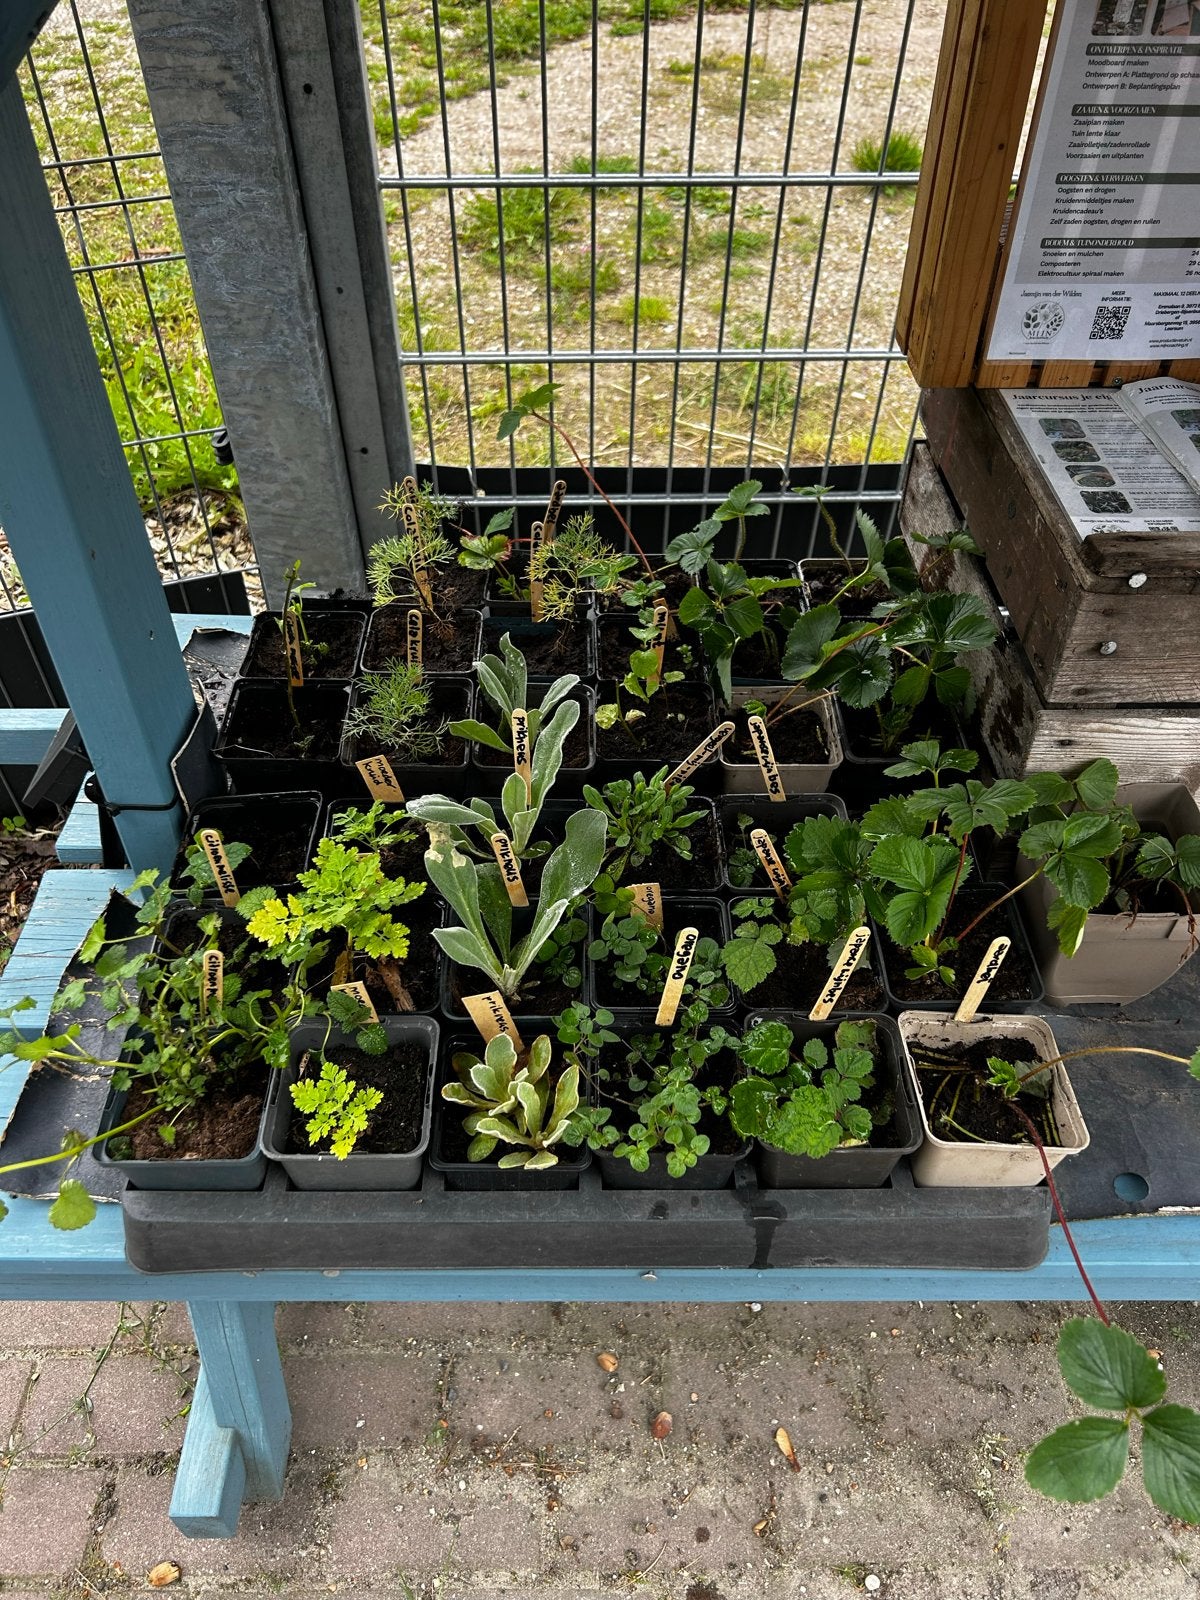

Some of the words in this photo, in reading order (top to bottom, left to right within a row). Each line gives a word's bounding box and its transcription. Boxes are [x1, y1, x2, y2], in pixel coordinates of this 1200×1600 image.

[1128, 83, 1181, 91] Beplantingsplan
[1076, 106, 1102, 114] ZAAIEN
[1110, 106, 1156, 114] VOORZAAIEN
[1073, 119, 1101, 127] Zaaiplan
[1111, 152, 1144, 160] uitplanten
[672, 934, 696, 980] oregano
